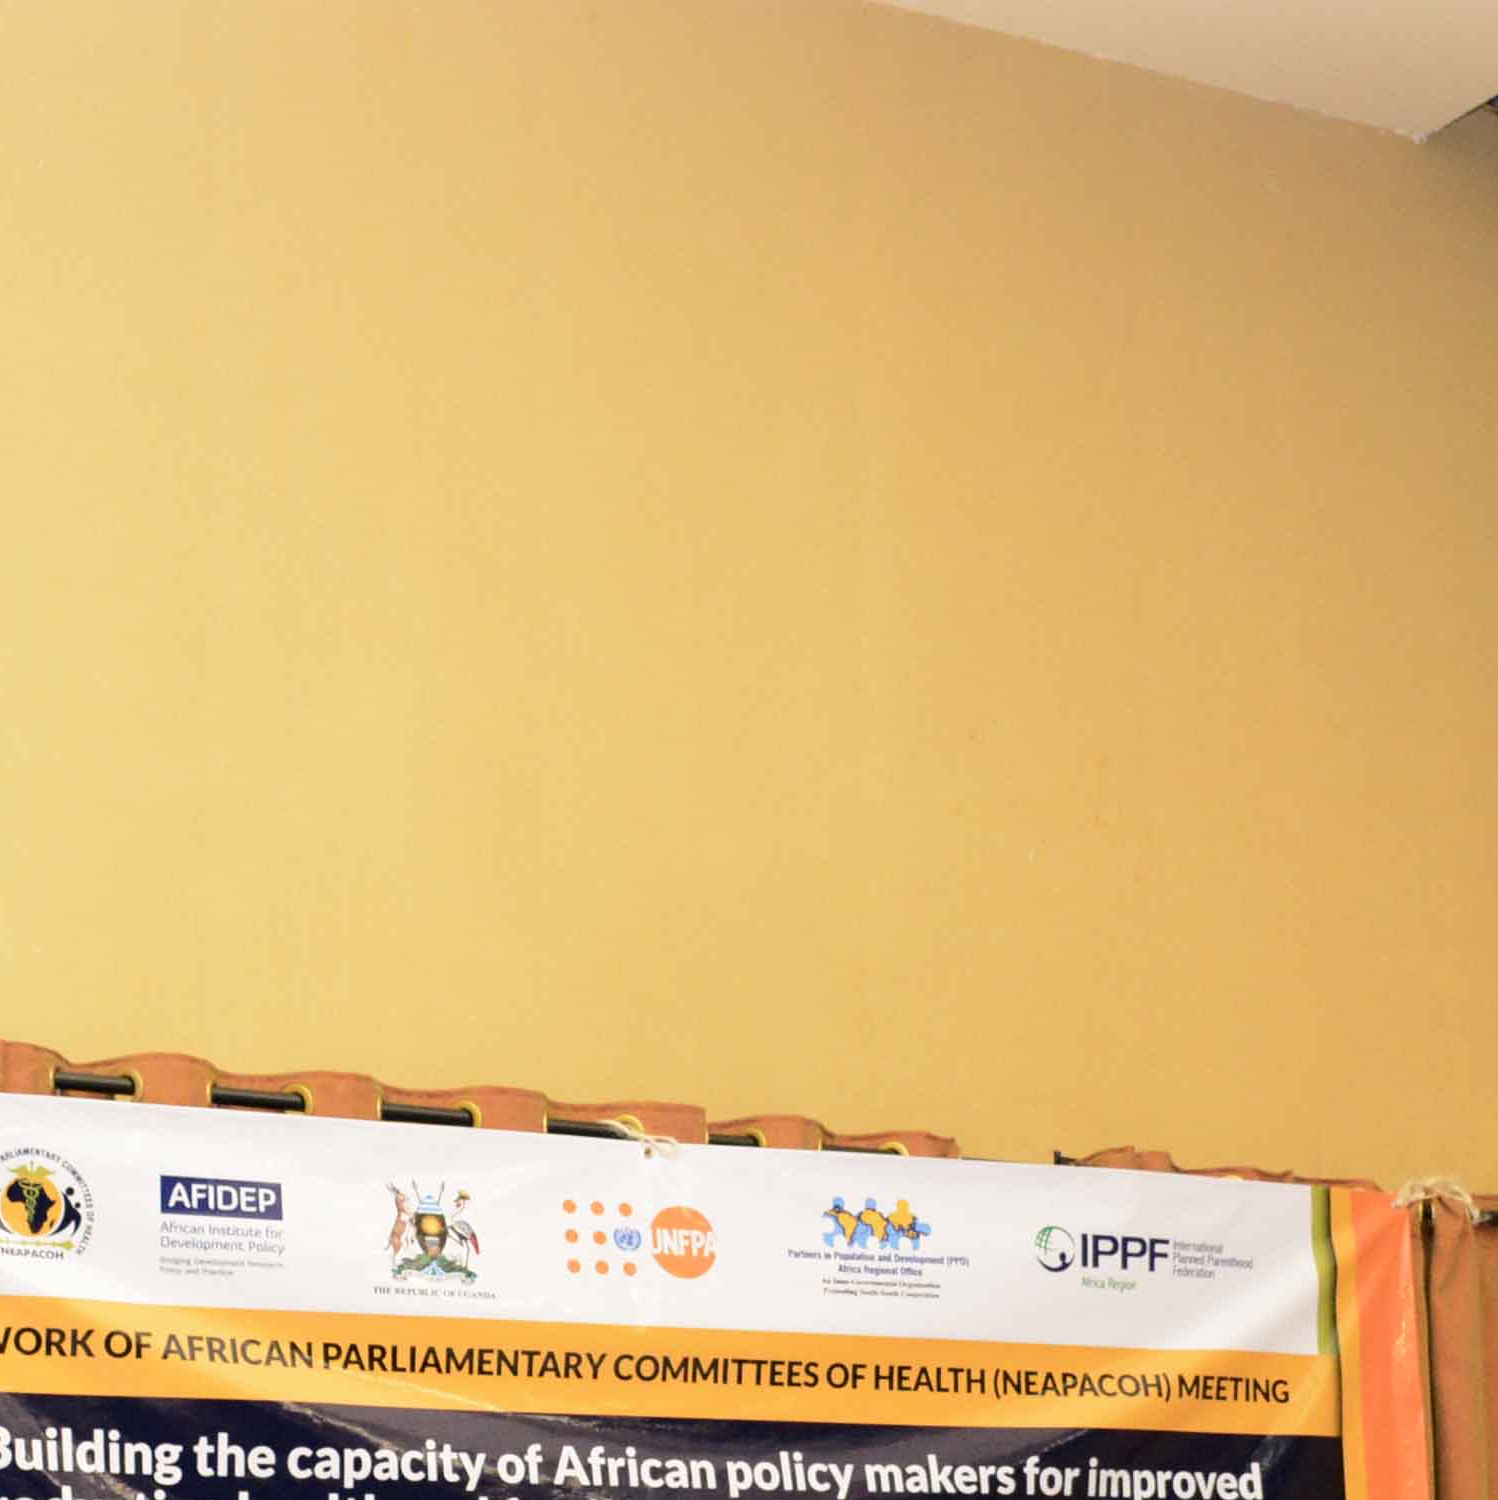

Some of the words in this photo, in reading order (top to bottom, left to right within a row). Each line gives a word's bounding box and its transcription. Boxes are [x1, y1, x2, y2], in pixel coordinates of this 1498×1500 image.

[167, 1182, 275, 1213] AFIDEP
[0, 1247, 65, 1260] NEAPACOH
[649, 1228, 718, 1258] UNFPA
[1082, 1234, 1169, 1271] IPPF
[104, 1331, 150, 1358] OF
[161, 1334, 313, 1368] AFRICAN
[323, 1343, 606, 1379] PARLIAMENTARY
[614, 1355, 819, 1387] COMMITTEES
[827, 1363, 866, 1389] OF
[875, 1365, 985, 1394] HEALTH
[994, 1368, 1171, 1403] (NEAPACOH)
[1178, 1375, 1289, 1403] MEETING
[193, 1432, 275, 1478] the
[288, 1438, 490, 1491] capacity
[497, 1444, 543, 1484] of
[554, 1445, 716, 1489] African
[726, 1451, 853, 1499] policy
[865, 1454, 1015, 1494] makers
[1023, 1456, 1080, 1496] for
